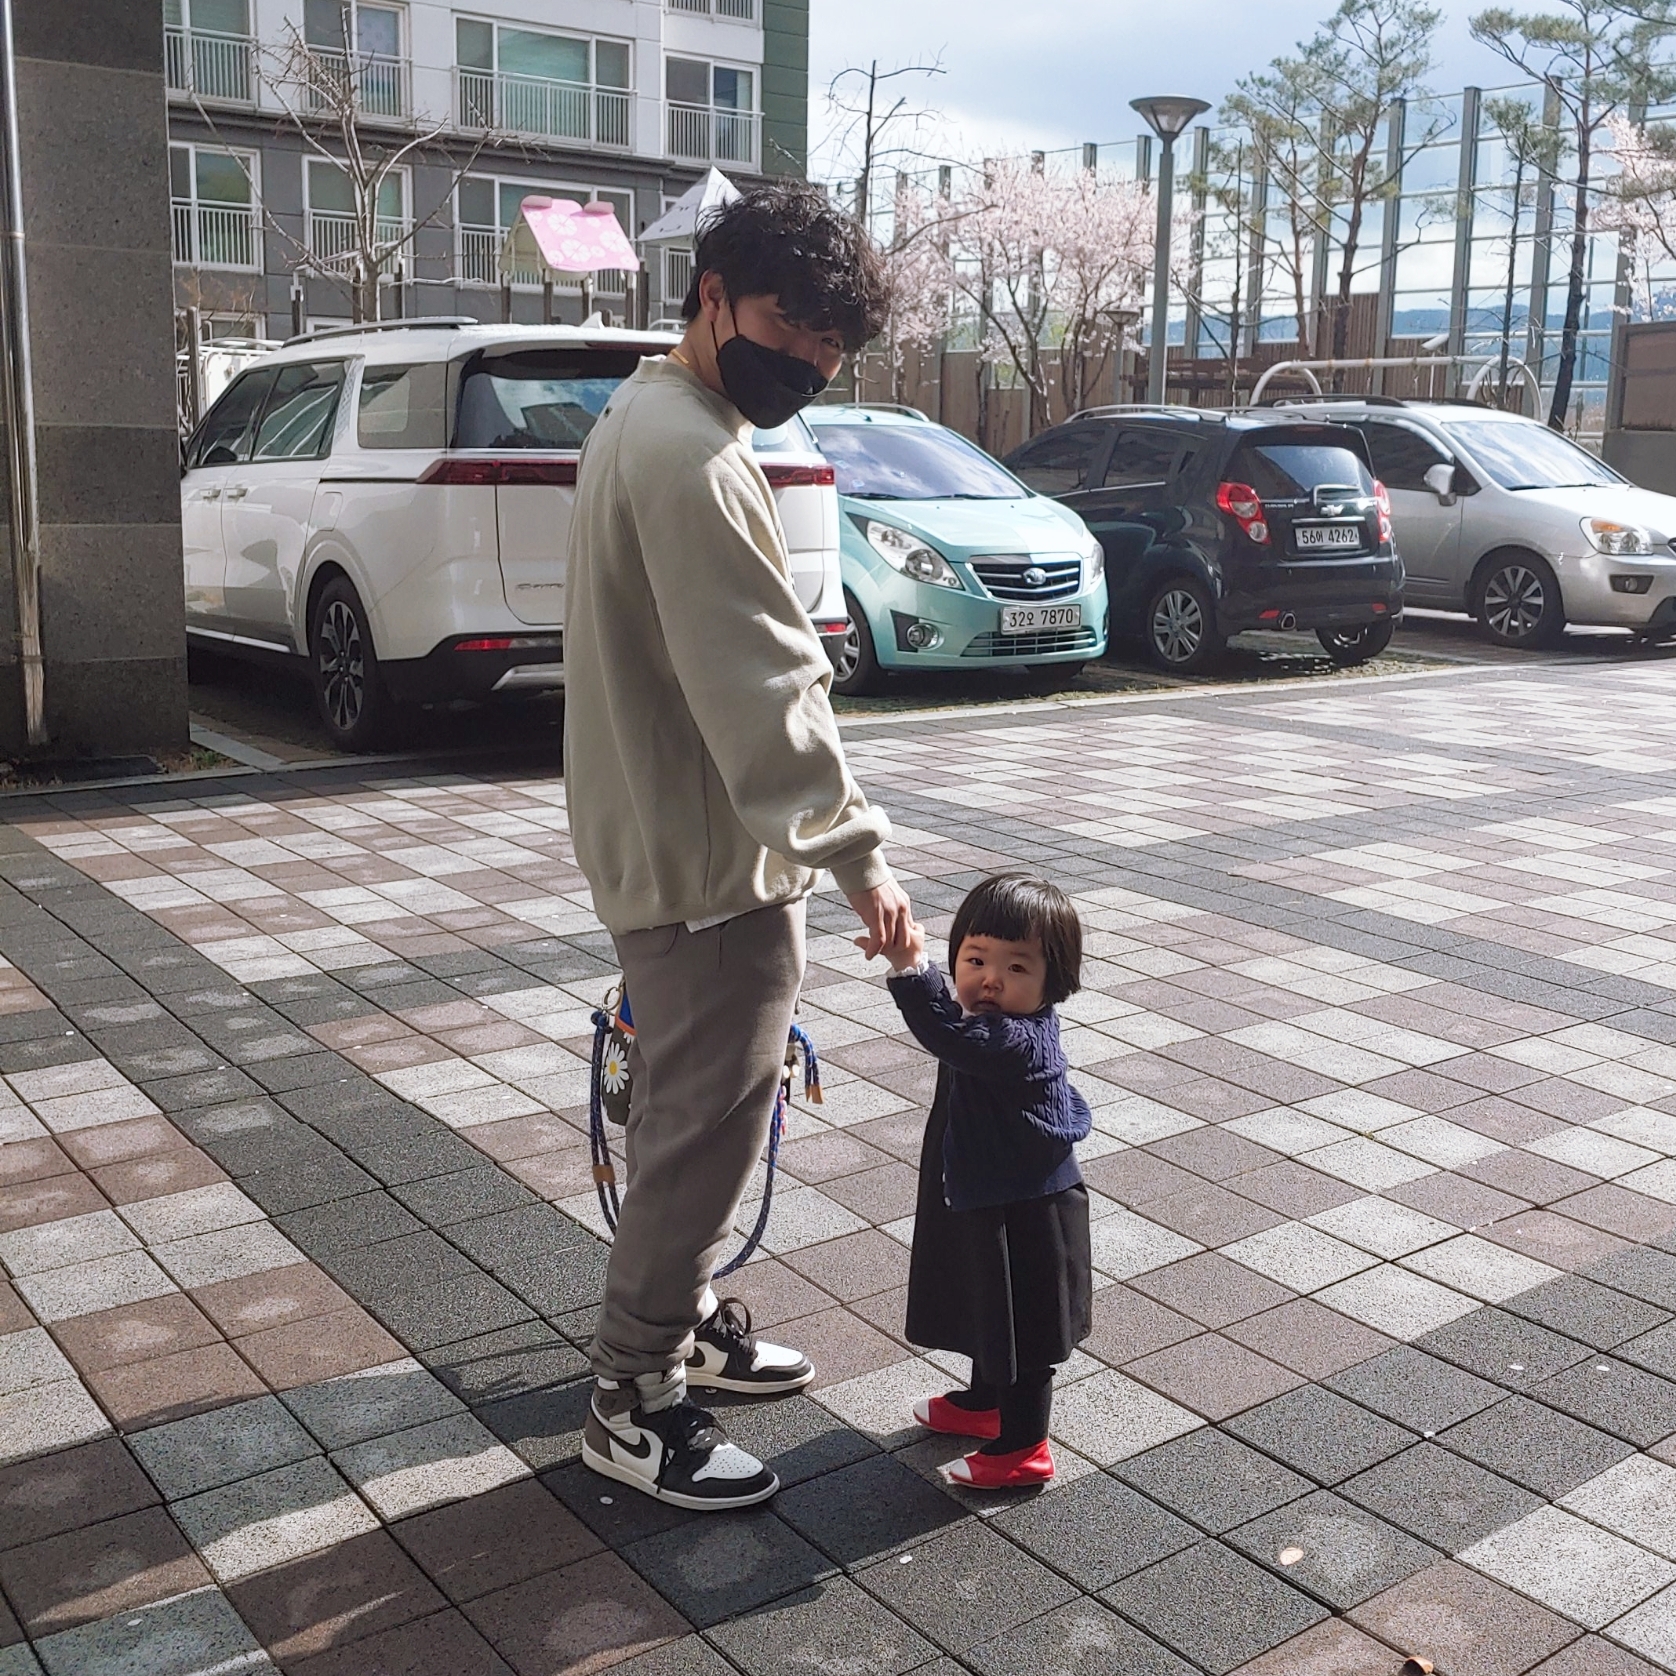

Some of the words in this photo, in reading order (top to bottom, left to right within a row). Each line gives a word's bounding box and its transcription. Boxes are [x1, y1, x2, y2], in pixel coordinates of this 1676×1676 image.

[1328, 528, 1355, 544] 4262
[1009, 611, 1035, 628] 32오
[1040, 608, 1074, 626] 7870
